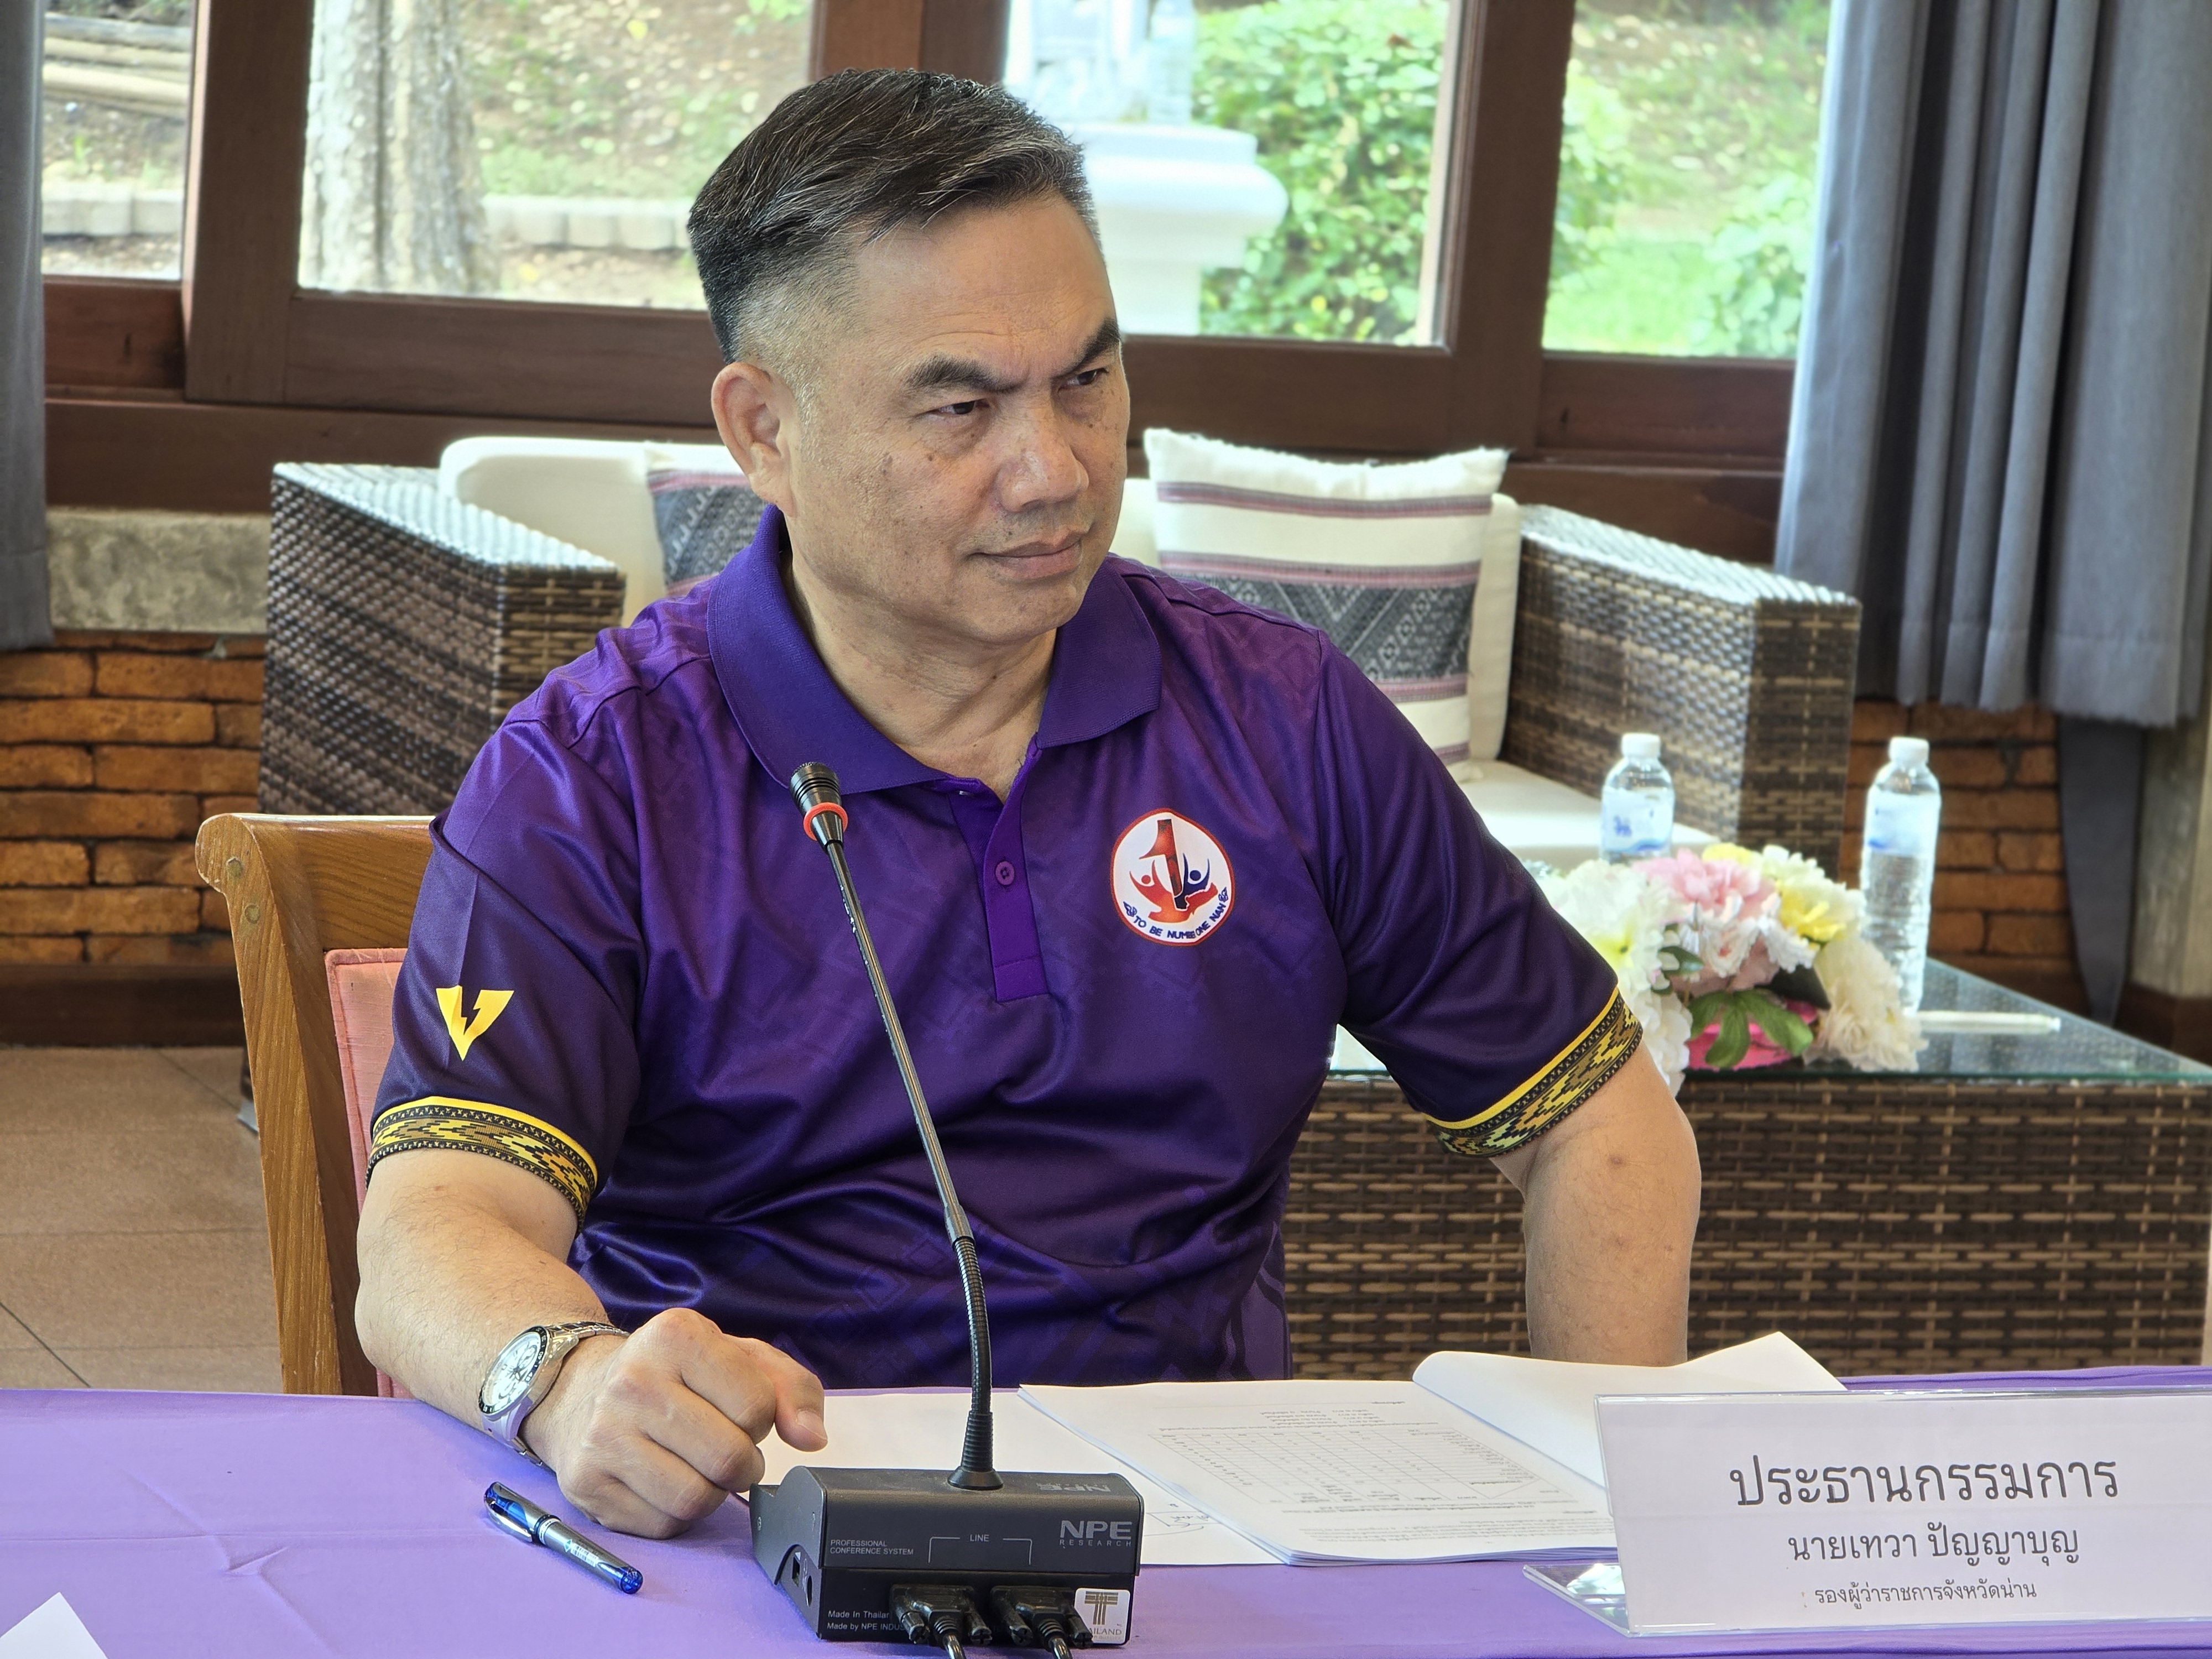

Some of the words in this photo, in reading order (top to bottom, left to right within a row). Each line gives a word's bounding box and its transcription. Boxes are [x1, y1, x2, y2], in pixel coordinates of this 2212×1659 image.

[1134, 915, 1147, 928] TO
[1149, 926, 1163, 936] BE
[1195, 920, 1211, 936] ONE
[1209, 902, 1227, 922] NAN
[1729, 1454, 2118, 1506] ประธานกรรมการ
[1060, 1520, 1133, 1540] NPE
[1788, 1533, 1917, 1561] นายเทวา
[1927, 1521, 2079, 1567] ปัญญาบุญ
[1814, 1577, 2037, 1610] รองผู้ว่าราชการจังหวัดน่าน
[828, 1610, 850, 1618] Made
[850, 1623, 859, 1631] by
